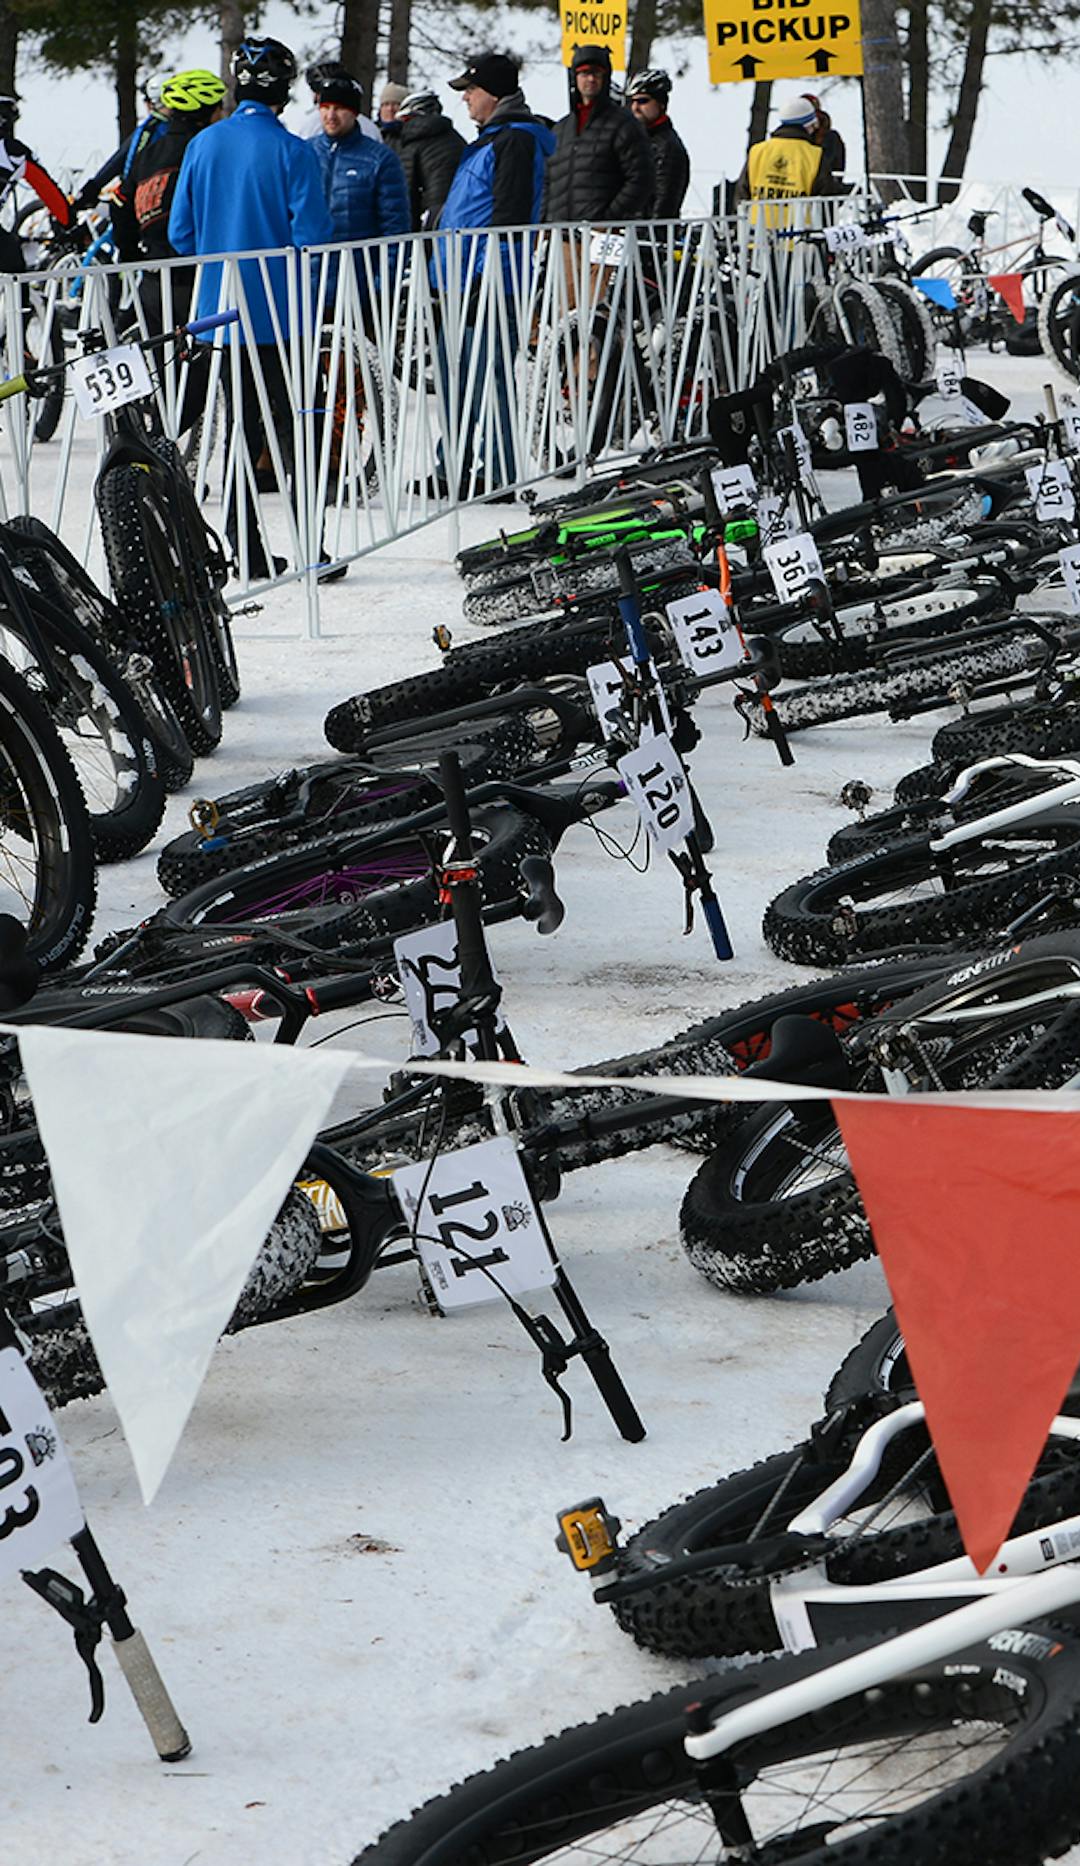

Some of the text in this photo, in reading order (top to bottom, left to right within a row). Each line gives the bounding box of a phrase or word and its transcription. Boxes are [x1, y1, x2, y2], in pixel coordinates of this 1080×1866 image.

[566, 11, 622, 36] PICKUP
[716, 15, 851, 46] PICKUP
[833, 230, 857, 244] 343
[85, 361, 134, 404] 539
[943, 371, 960, 394] 184
[852, 411, 870, 443] 482
[1037, 475, 1061, 507] 497
[682, 607, 724, 659] 143
[637, 762, 680, 829] 120
[428, 1181, 510, 1277] 121
